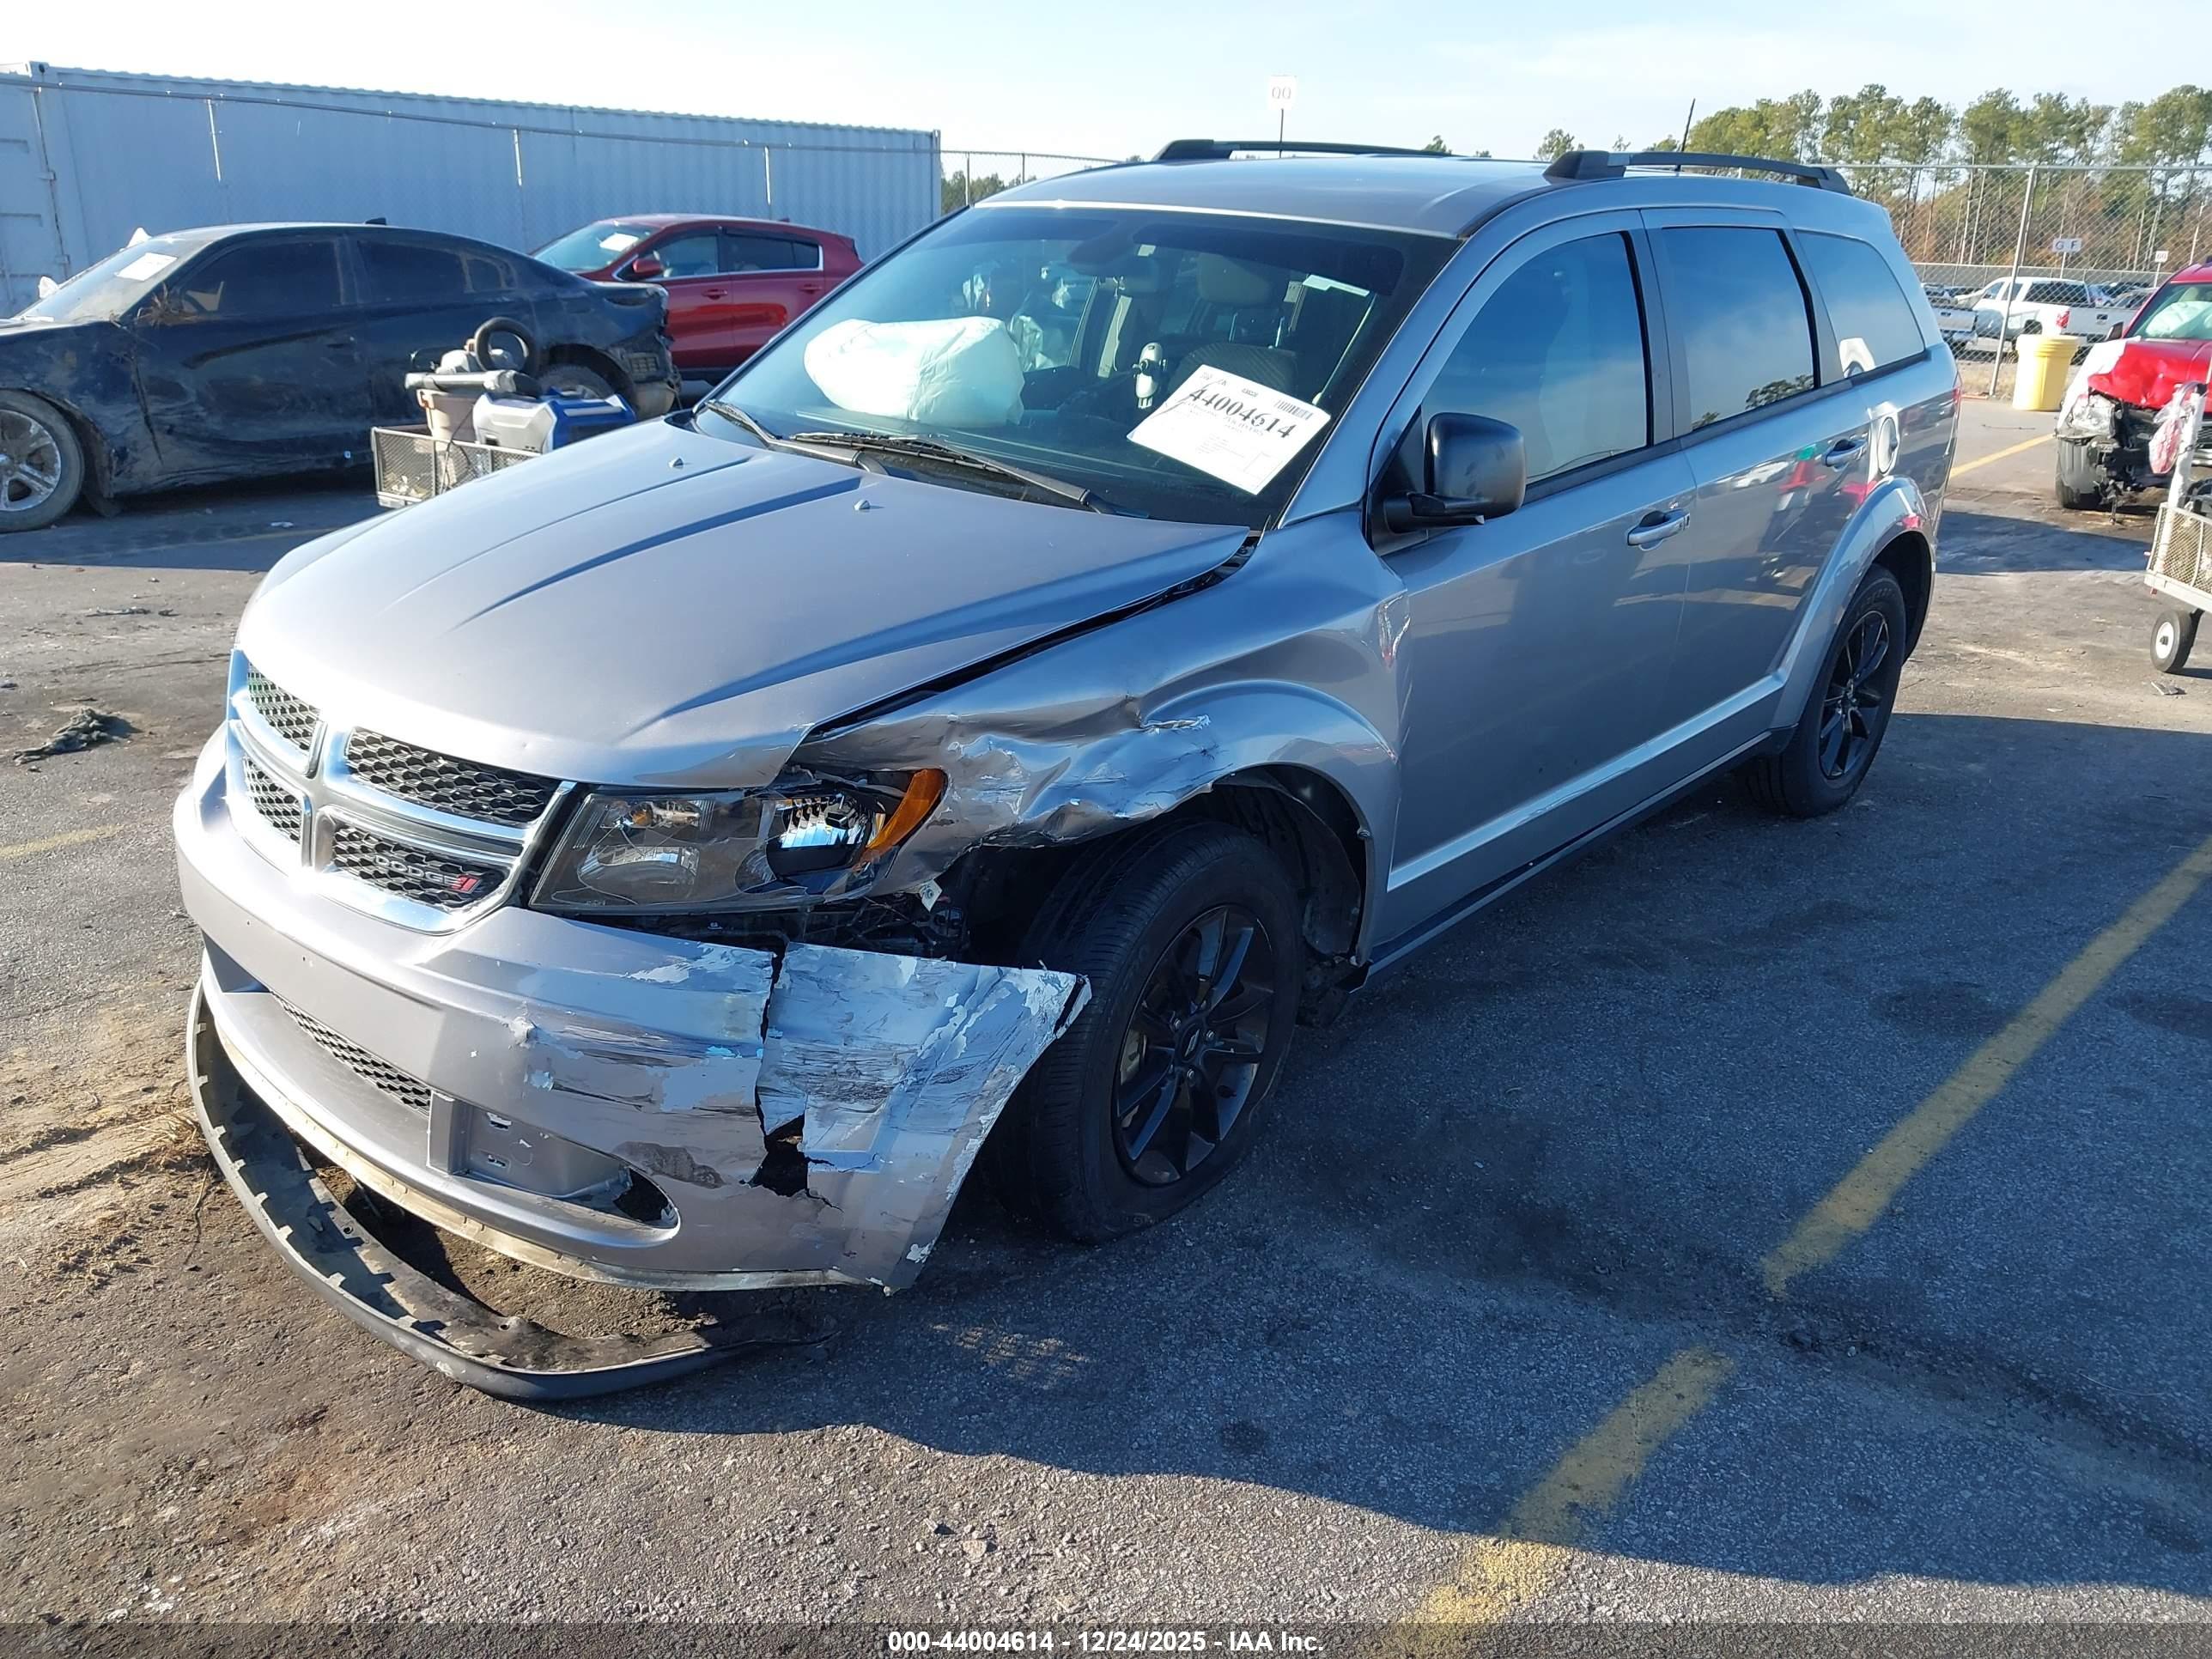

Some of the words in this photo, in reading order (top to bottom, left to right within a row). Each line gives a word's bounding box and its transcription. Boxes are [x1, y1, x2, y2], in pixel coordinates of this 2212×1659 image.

[2070, 240, 2078, 250] F
[1189, 388, 1297, 439] 44004614
[374, 854, 461, 887] DODGE
